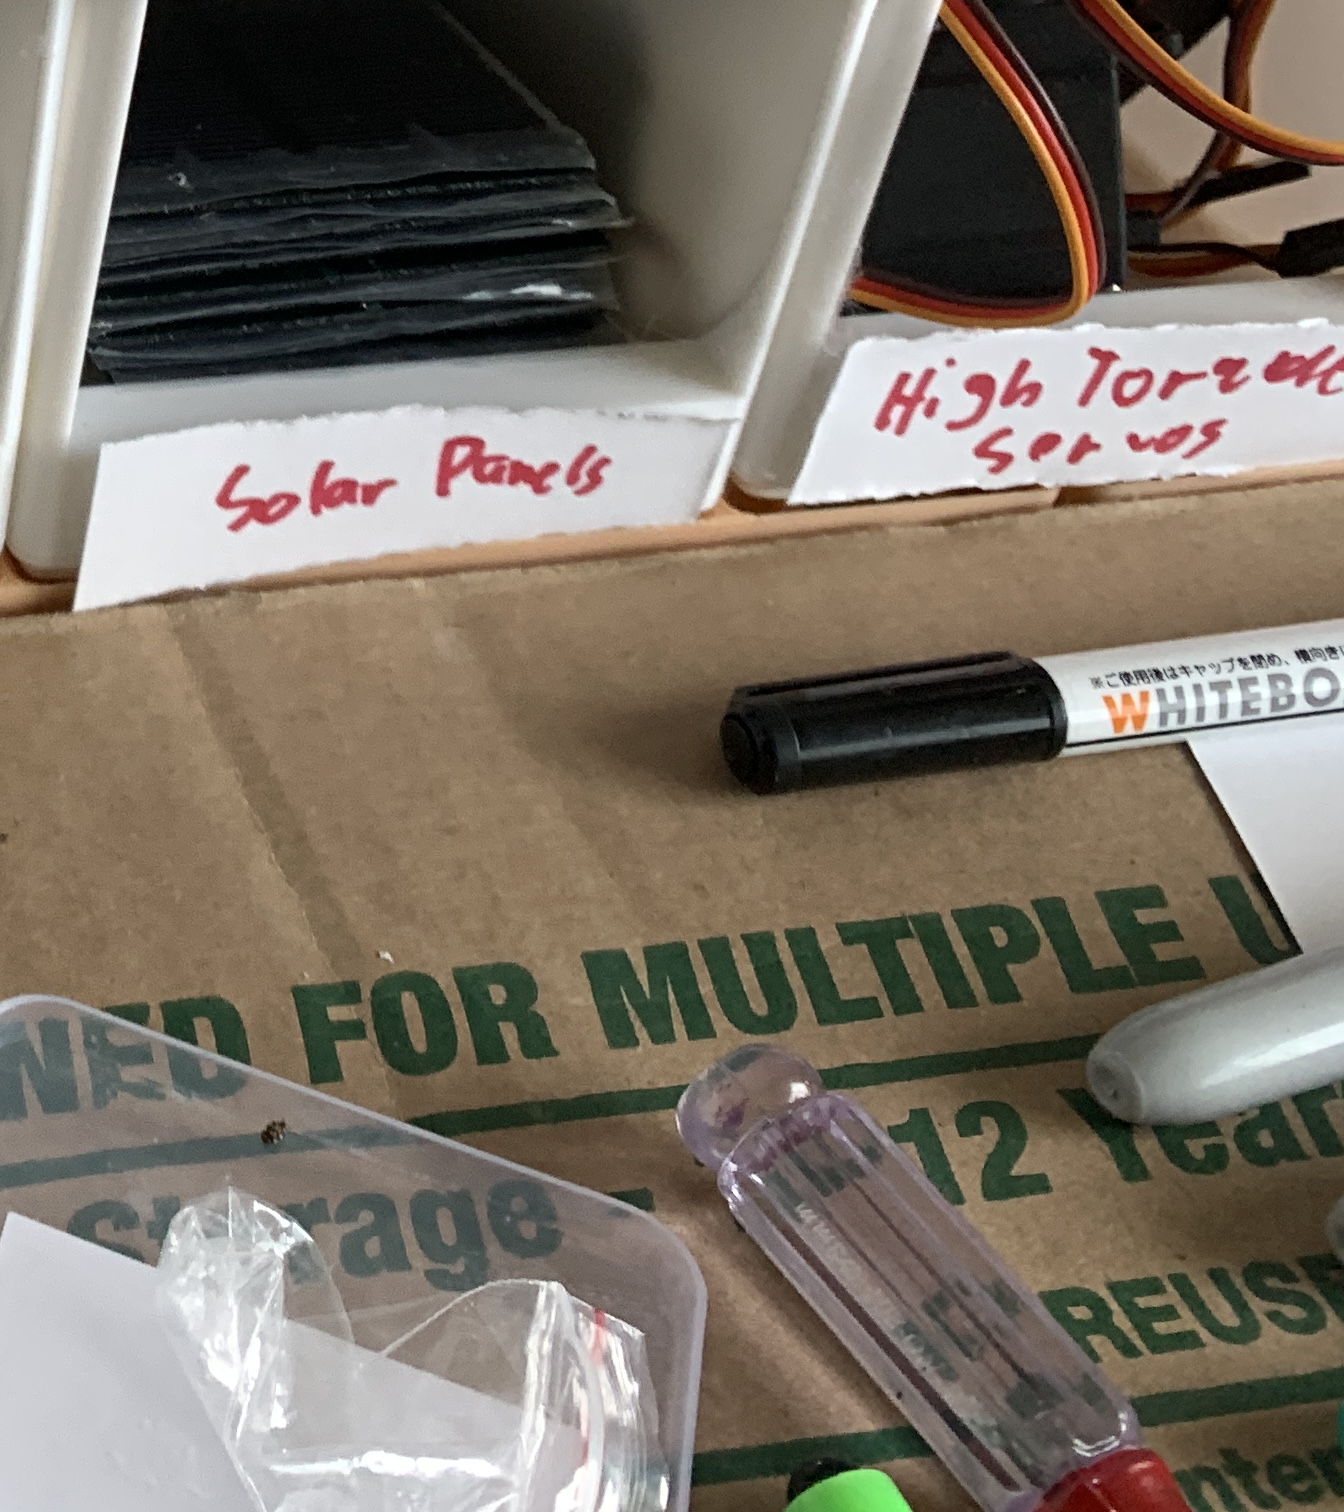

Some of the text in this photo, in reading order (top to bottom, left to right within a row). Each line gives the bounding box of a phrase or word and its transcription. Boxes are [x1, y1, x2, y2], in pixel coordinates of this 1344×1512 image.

[874, 357, 1043, 436] High
[215, 434, 612, 532] Solar Panels
[292, 961, 560, 1086] FOR
[582, 883, 1206, 1050] MULTIPLE
[1209, 876, 1301, 965] U
[67, 1180, 568, 1293] Strage
[886, 1100, 1054, 1206] 12
